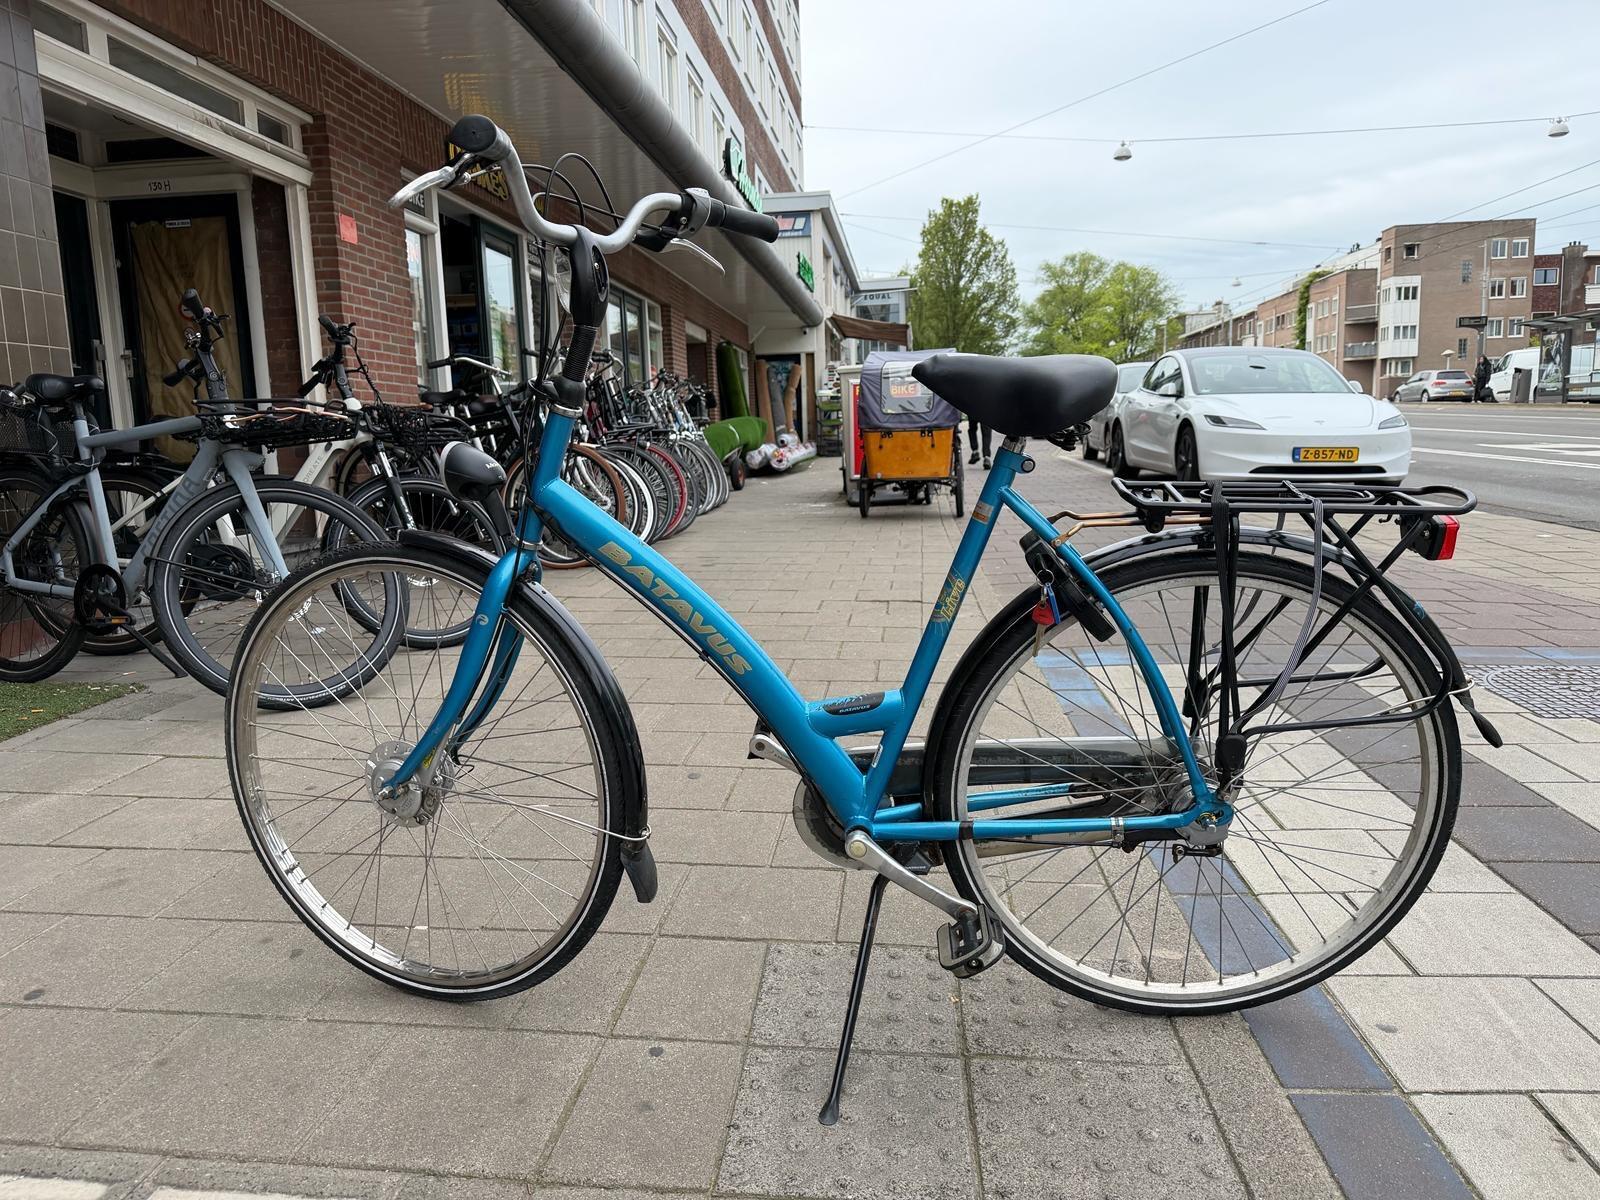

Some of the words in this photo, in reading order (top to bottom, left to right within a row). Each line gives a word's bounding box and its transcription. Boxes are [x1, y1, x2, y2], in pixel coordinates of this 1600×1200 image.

[890, 384, 916, 395] BIKE
[1303, 449, 1354, 460] Z-857-ND
[599, 541, 753, 675] BATAVUS
